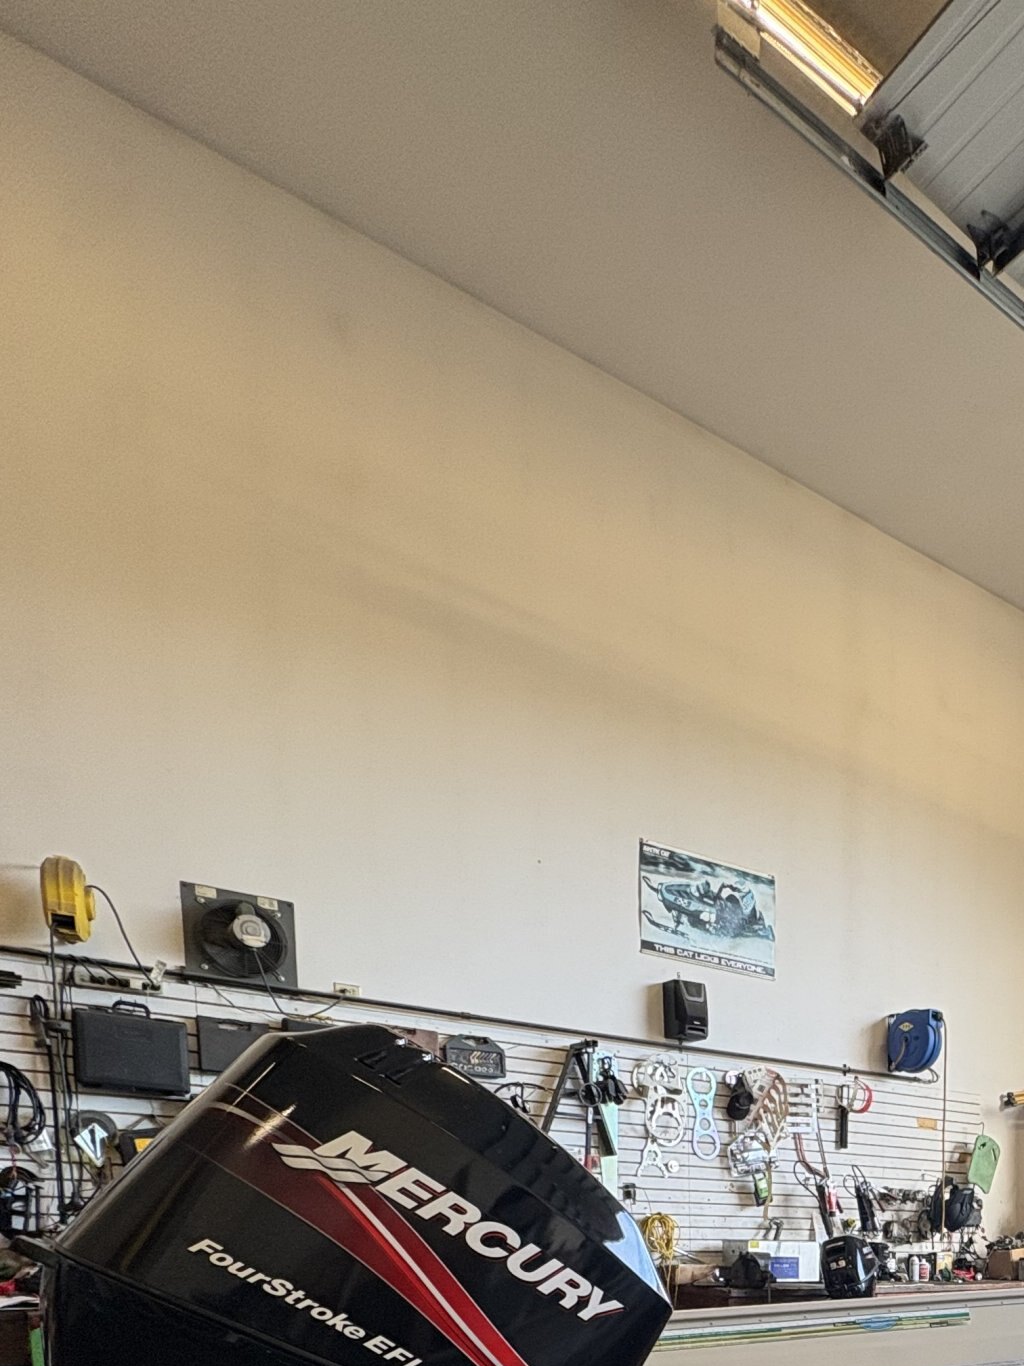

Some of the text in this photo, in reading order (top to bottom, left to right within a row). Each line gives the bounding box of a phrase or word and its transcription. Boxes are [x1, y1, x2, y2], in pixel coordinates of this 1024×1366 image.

[654, 943, 675, 954] THIS
[677, 948, 694, 958] CAT
[313, 1130, 625, 1322] MERCURY
[187, 1238, 366, 1340] FourStroke
